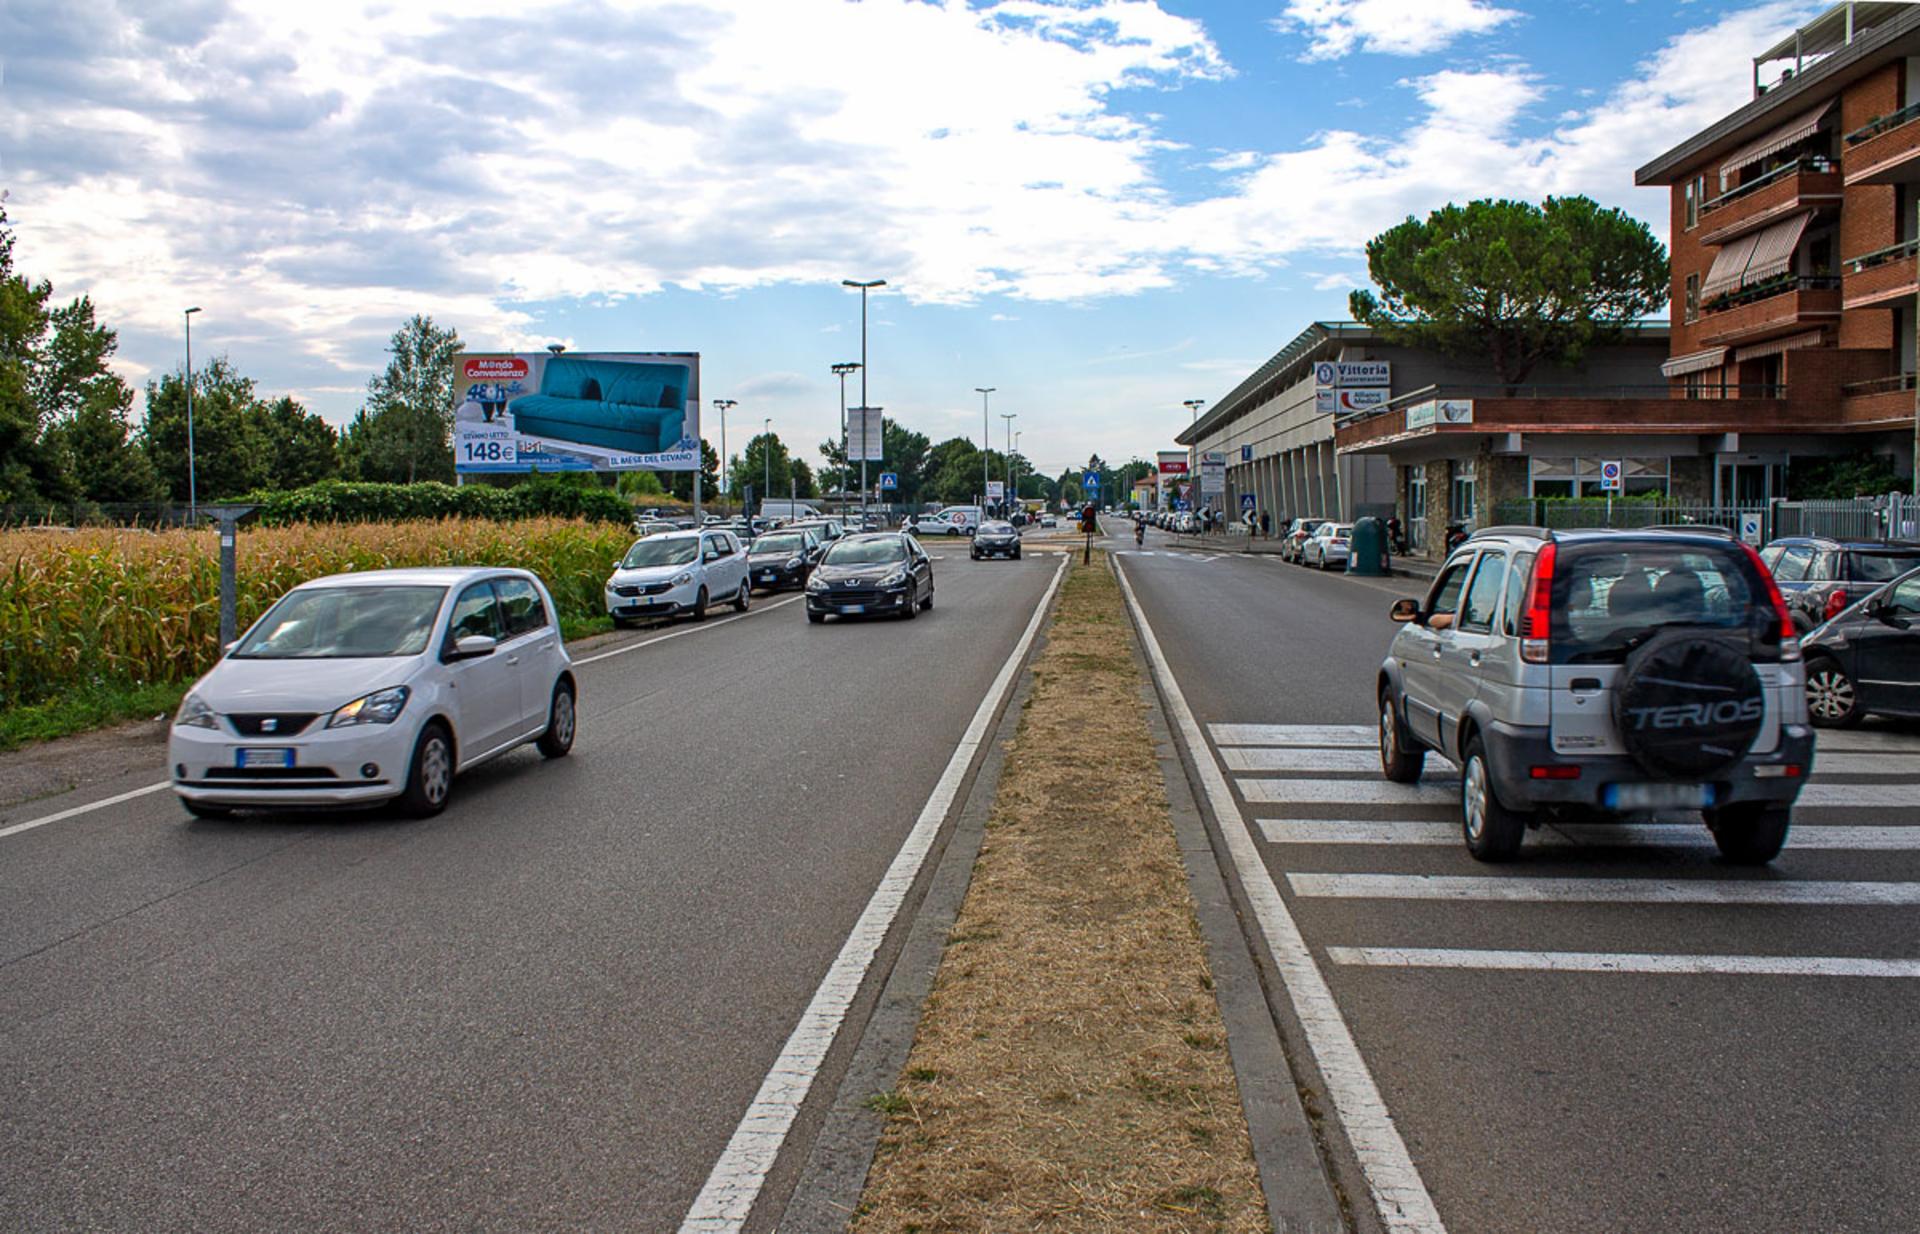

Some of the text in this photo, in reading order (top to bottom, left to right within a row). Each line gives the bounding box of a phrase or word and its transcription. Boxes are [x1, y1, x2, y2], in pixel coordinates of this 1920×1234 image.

[467, 369, 524, 377] Convenienza
[1338, 365, 1388, 375] Vittoria
[661, 452, 693, 462] DIVANO
[1627, 698, 1761, 730] TERIOS
